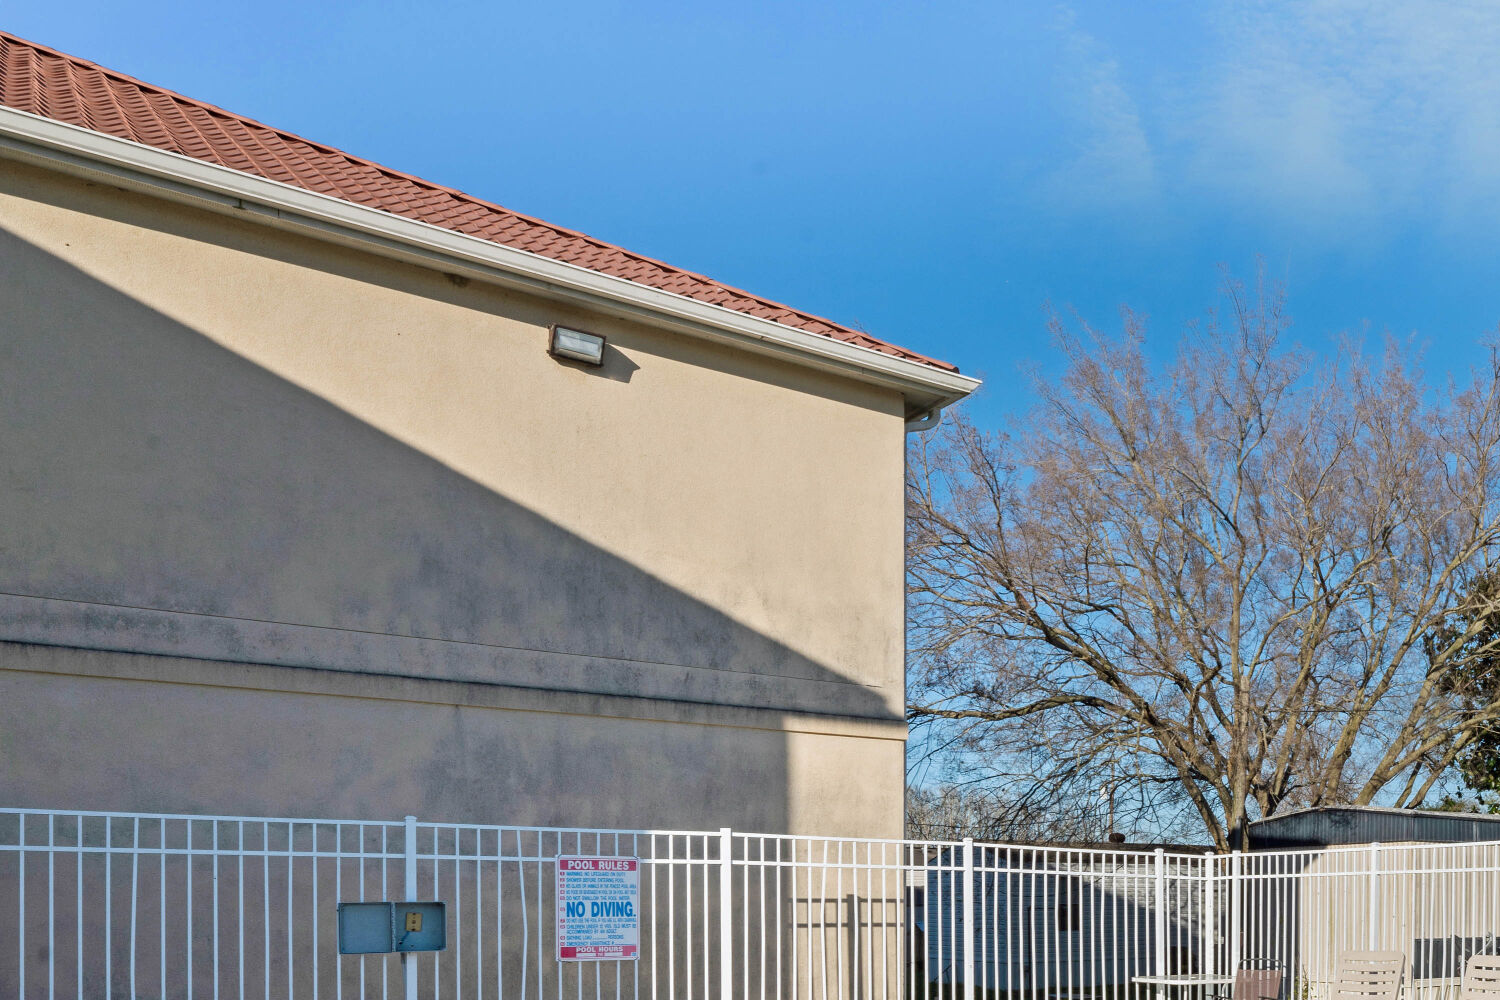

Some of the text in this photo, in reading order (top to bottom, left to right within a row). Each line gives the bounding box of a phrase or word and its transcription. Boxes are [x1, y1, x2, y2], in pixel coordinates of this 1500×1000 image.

[567, 860, 629, 871] POOL RULES
[566, 901, 637, 918] NO DIVING.
